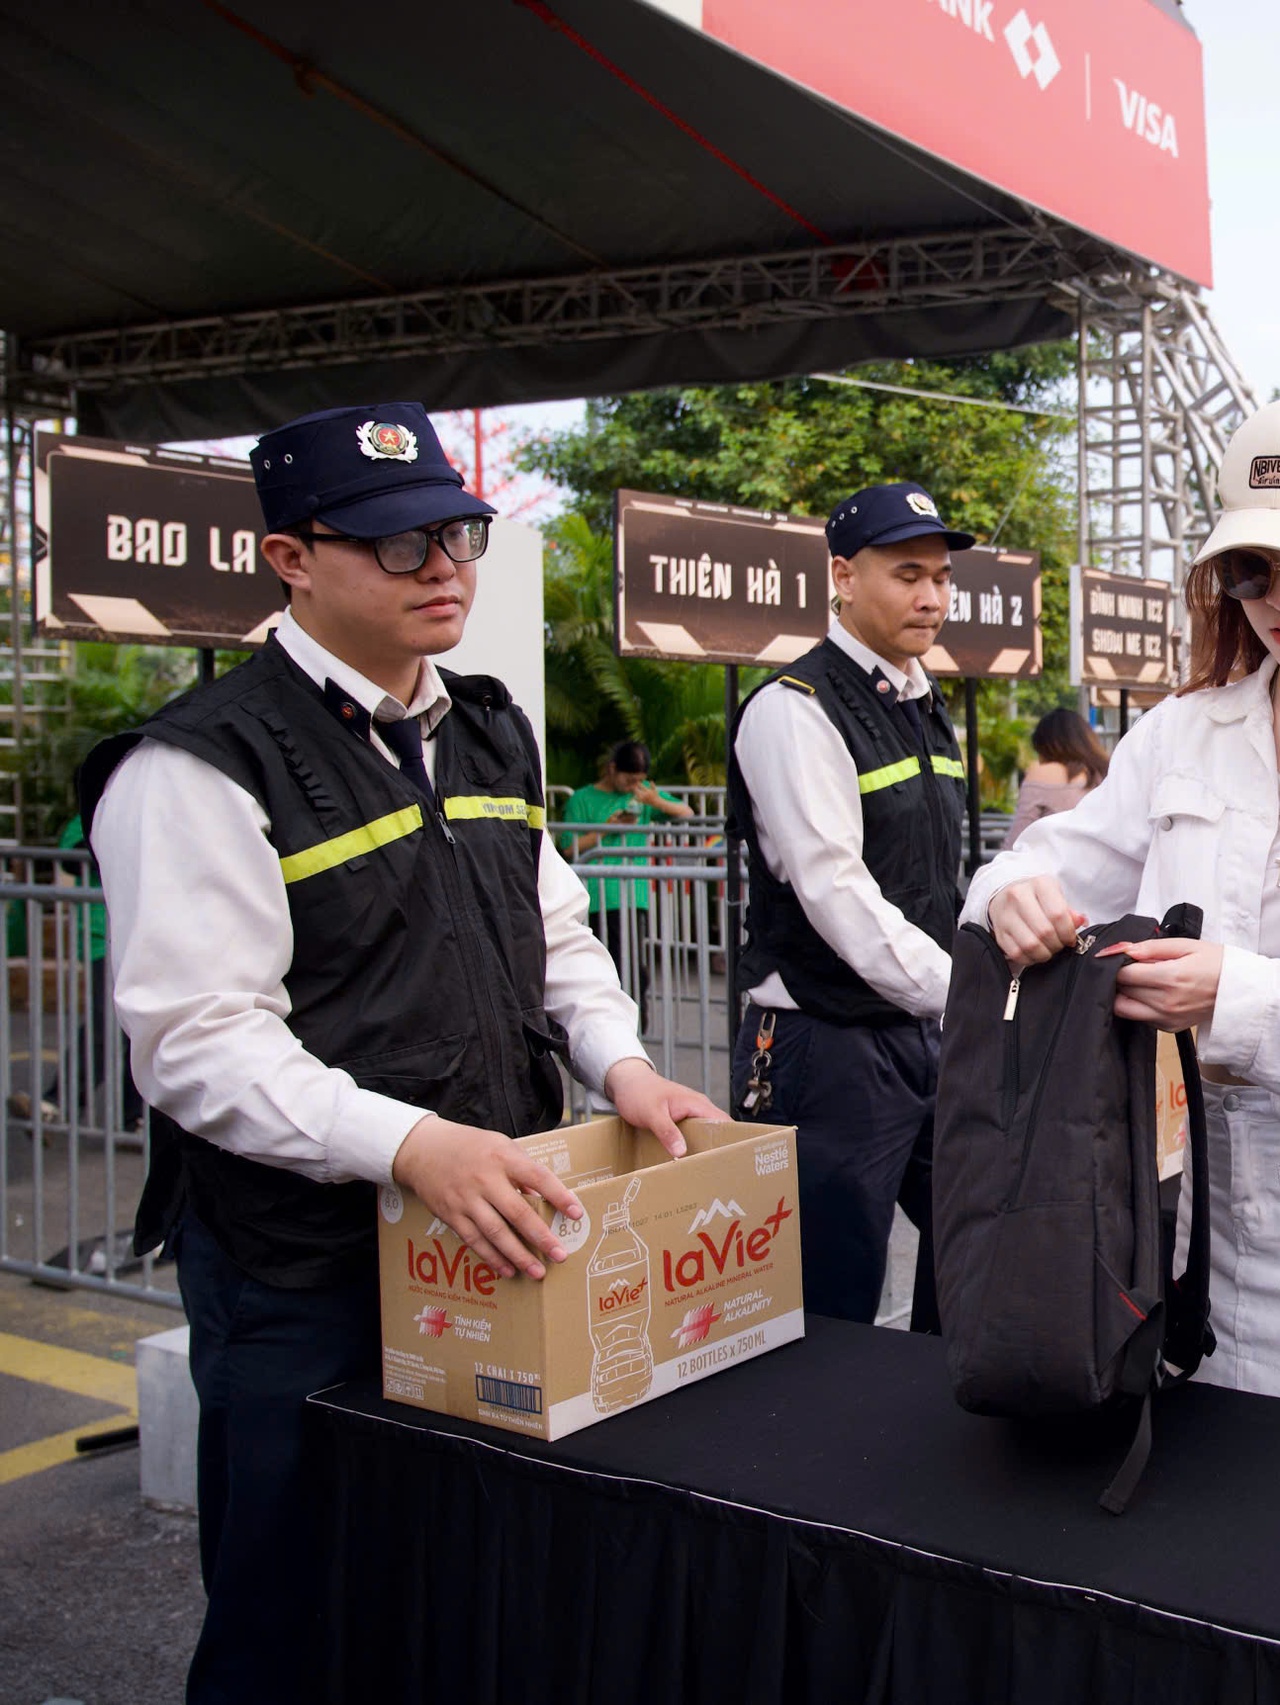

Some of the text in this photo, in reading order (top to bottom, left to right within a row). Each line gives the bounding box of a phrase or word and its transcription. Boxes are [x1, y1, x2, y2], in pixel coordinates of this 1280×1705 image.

[1113, 77, 1179, 158] VISA
[107, 514, 256, 574] BAO LA
[649, 552, 806, 608] THIÊN HÀ 1
[979, 585, 1003, 625] HÀ
[1010, 595, 1023, 626] 2
[755, 1145, 788, 1164] Nestlé
[755, 1159, 788, 1176] Waters
[665, 1263, 774, 1307] NATURAL ALKALINE MINERAL WATER
[724, 1289, 763, 1311] NATURAL
[724, 1296, 772, 1324] ALKALINITY
[475, 1362, 483, 1374] 12
[487, 1365, 506, 1379] CHAI
[677, 1361, 688, 1379] 12
[690, 1344, 728, 1374] BOTTLES
